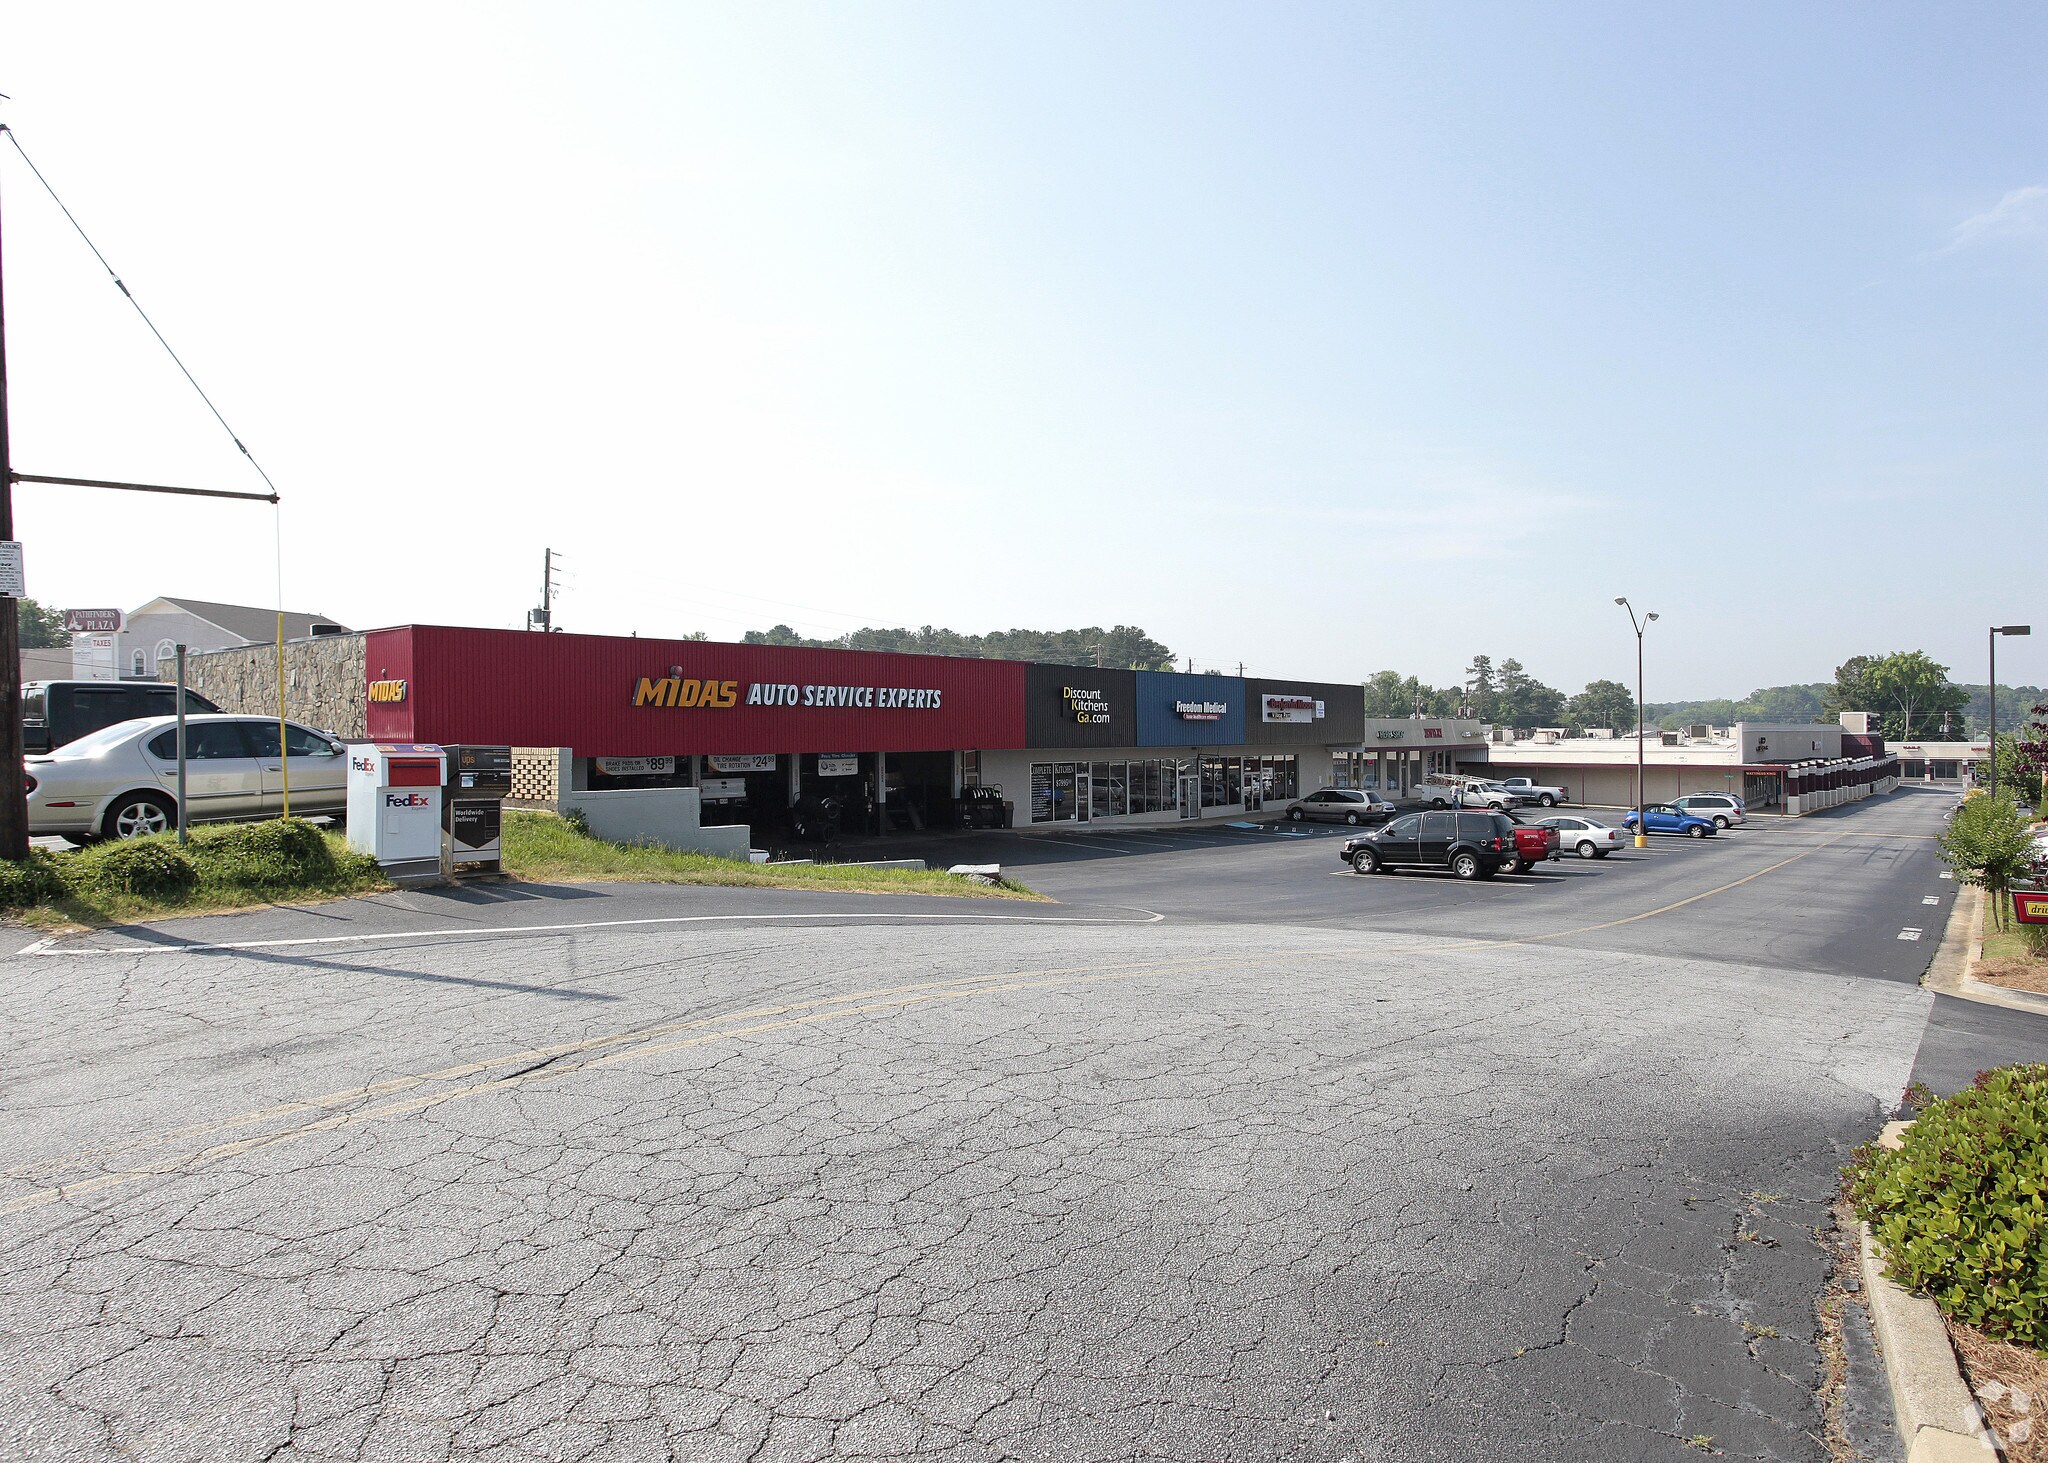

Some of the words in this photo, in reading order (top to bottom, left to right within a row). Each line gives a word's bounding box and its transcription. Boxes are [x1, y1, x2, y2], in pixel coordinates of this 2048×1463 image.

[75, 610, 116, 619] PATHFINDERS
[87, 620, 115, 630] PLAZA
[92, 639, 112, 647] TAXES
[368, 679, 407, 702] MIDAS
[632, 672, 738, 708] MIDAS
[746, 683, 799, 707] AUTO
[803, 685, 874, 708] SERVICE
[877, 687, 942, 709] EXPERTS
[1063, 686, 1101, 700] Discount
[1071, 698, 1109, 711] Kitchens
[1176, 700, 1203, 713] Freedom
[1203, 701, 1227, 714] Medical
[1077, 711, 1110, 723] Ga.com
[352, 757, 375, 772] FedEx
[461, 756, 475, 765] ups
[386, 793, 429, 807] FedEx
